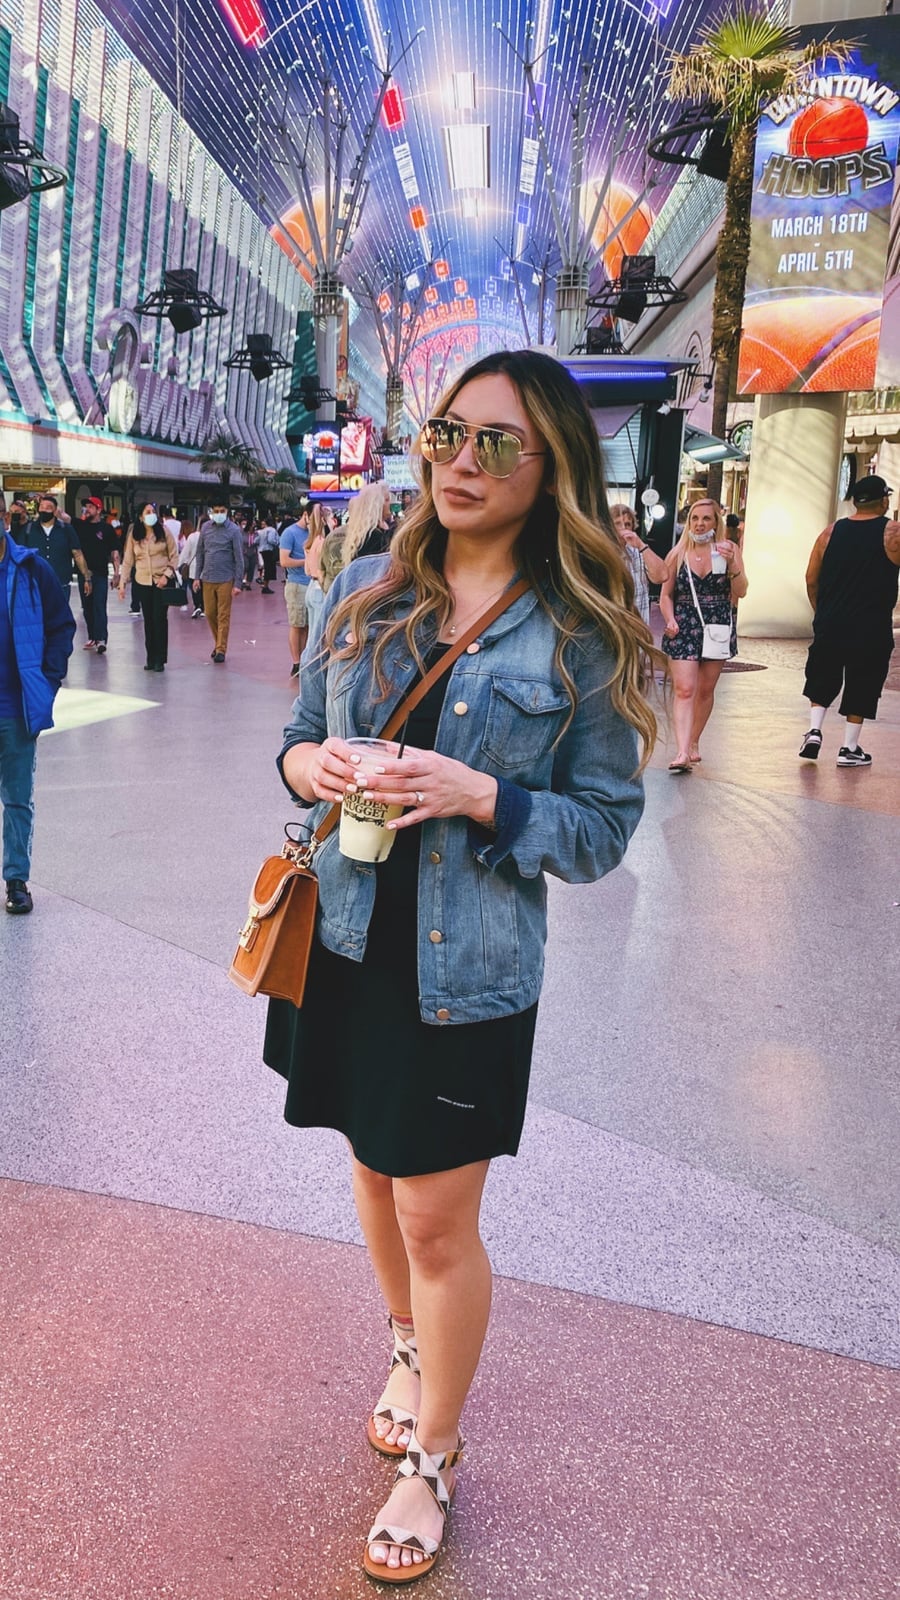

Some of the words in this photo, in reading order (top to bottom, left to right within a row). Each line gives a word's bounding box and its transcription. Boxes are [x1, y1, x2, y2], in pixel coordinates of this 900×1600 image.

[756, 143, 894, 198] HOOPS
[771, 215, 823, 238] MARCH
[829, 212, 868, 234] 18TH
[778, 254, 819, 273] APRIL
[824, 250, 854, 270] 5TH
[344, 800, 388, 818] NUGGET
